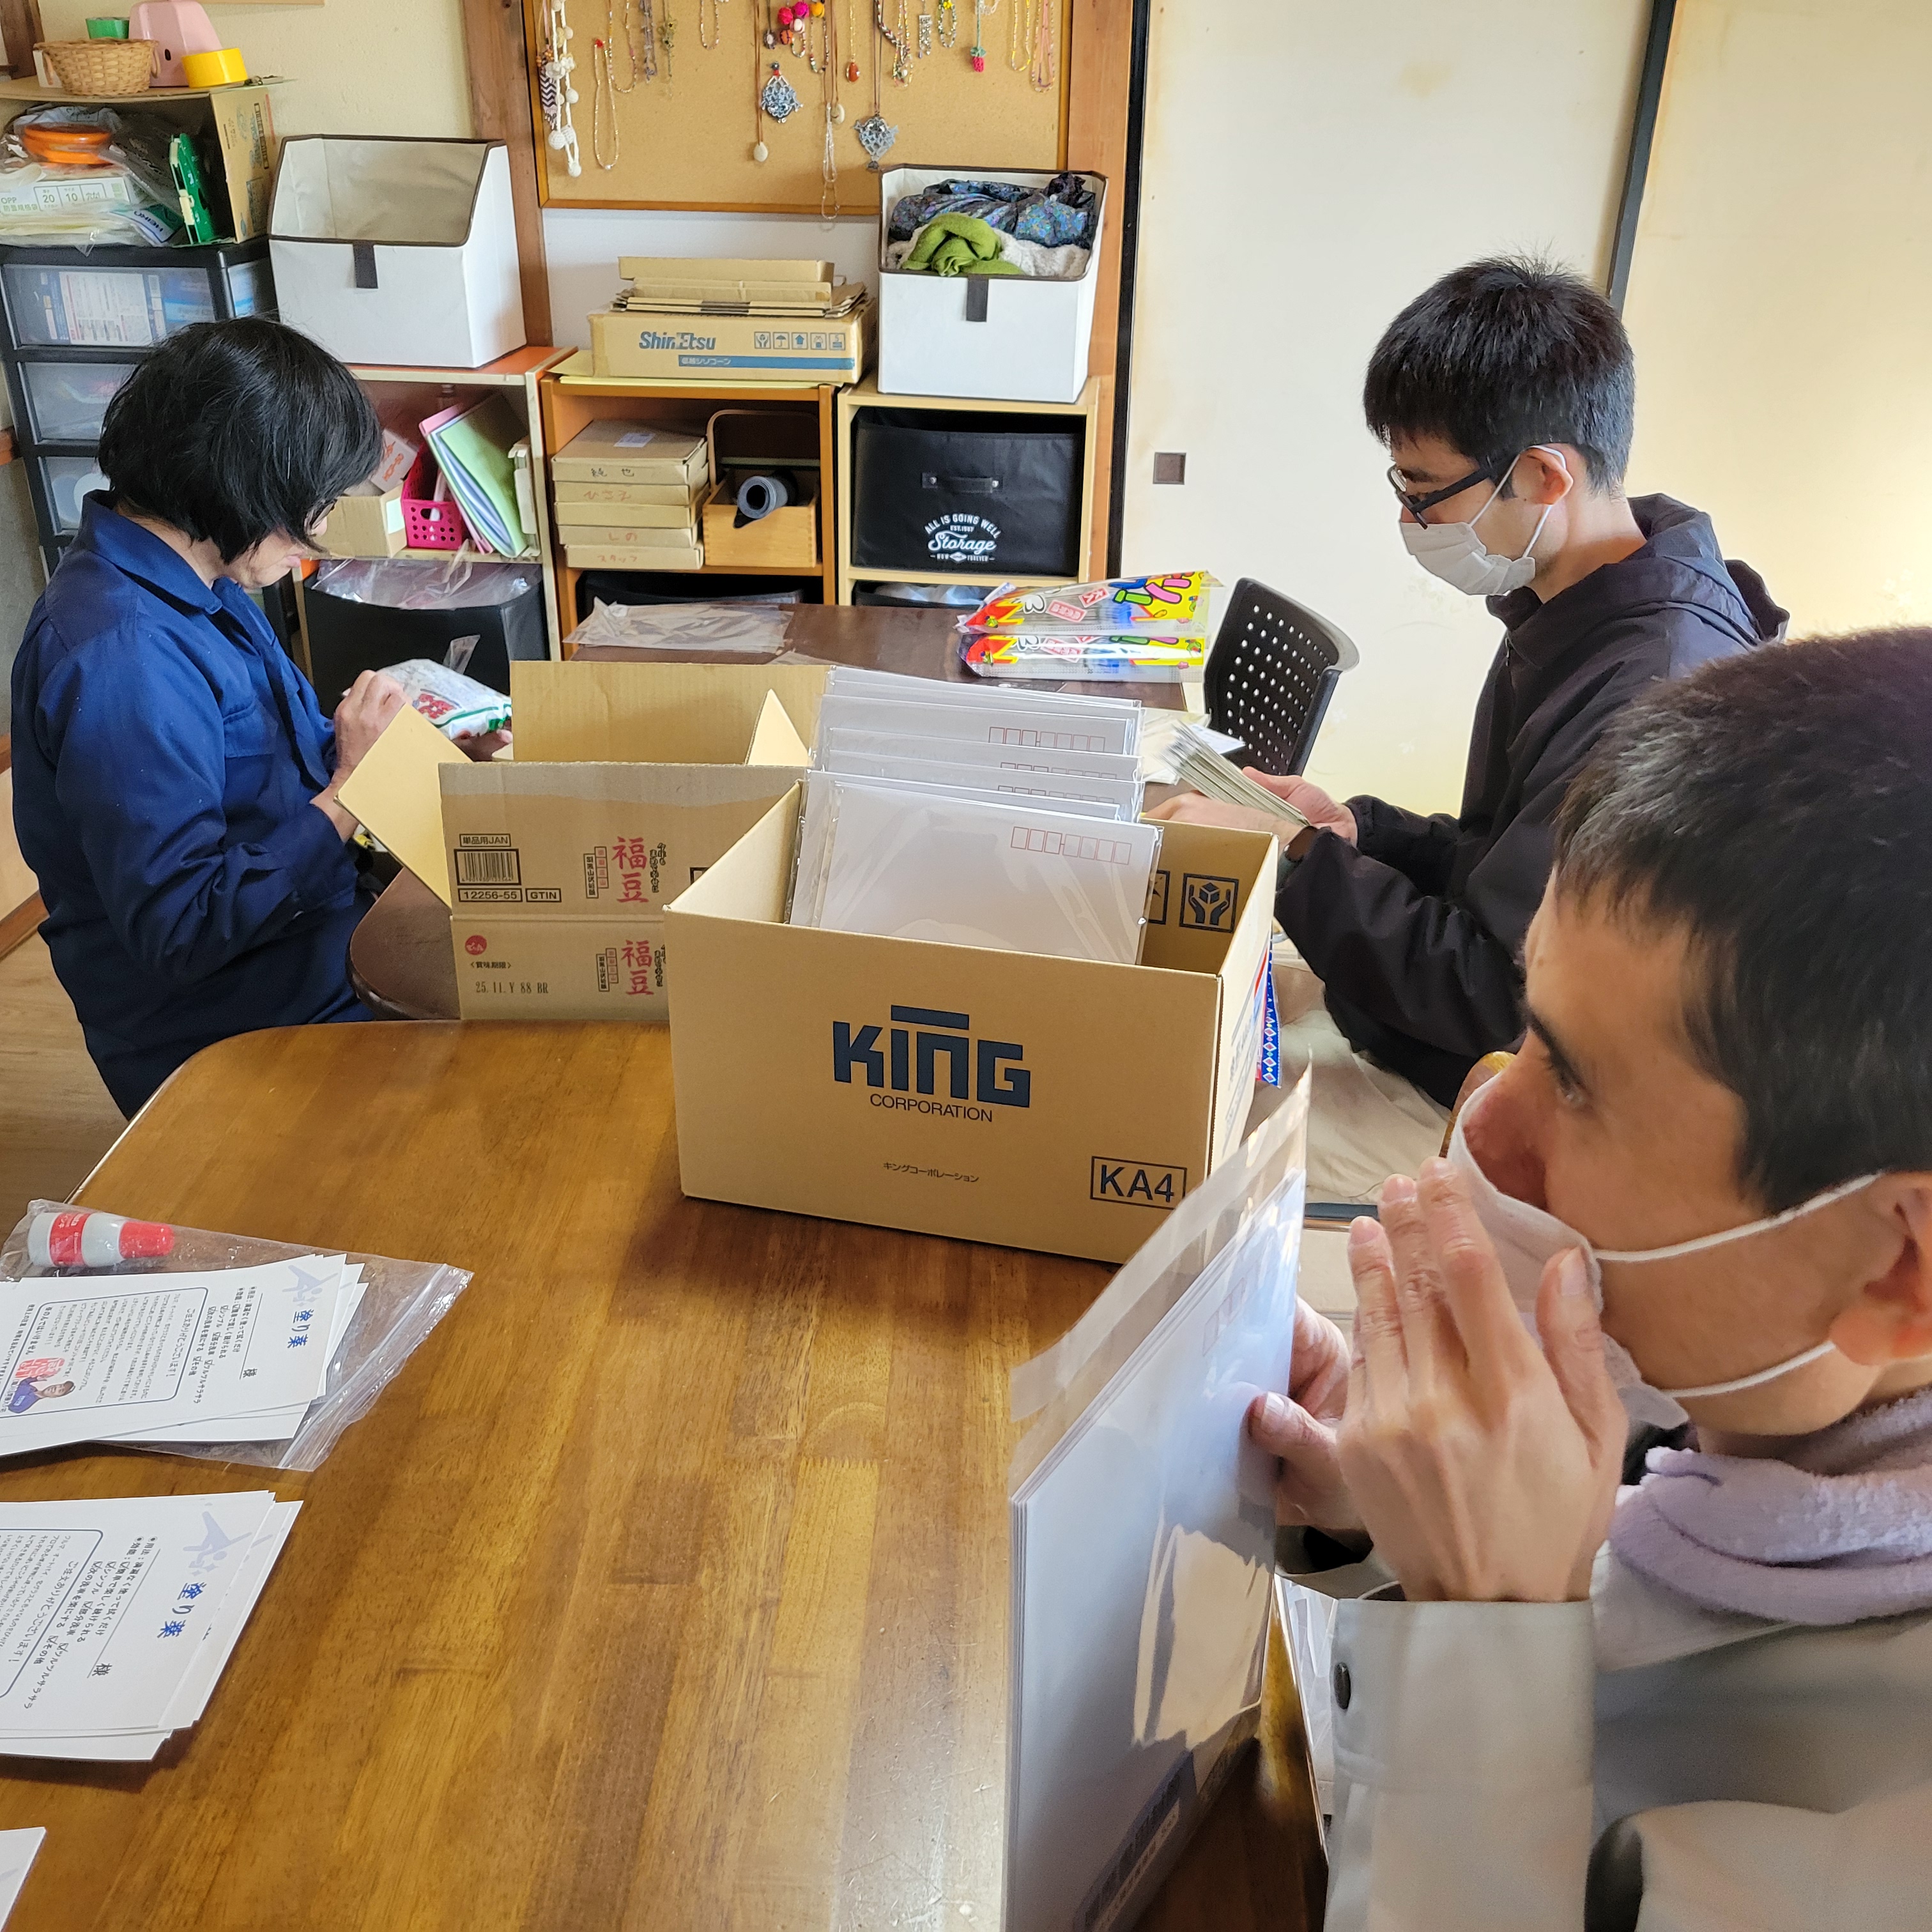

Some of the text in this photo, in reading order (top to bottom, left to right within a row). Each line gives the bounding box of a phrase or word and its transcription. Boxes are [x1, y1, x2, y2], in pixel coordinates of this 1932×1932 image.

[42, 194, 55, 203] 20
[65, 193, 78, 203] 10
[924, 513, 1002, 539] ALL IS GOING WELL
[928, 530, 997, 555] Storage
[463, 836, 509, 845] 単品用JAN
[611, 836, 650, 903] 福豆
[463, 891, 518, 900] 12256-55
[530, 891, 557, 900] GTIN
[620, 939, 655, 995] 福豆
[520, 982, 532, 994] 88
[537, 982, 549, 994] BR
[832, 1004, 1031, 1108] KING
[870, 1092, 993, 1123] CORPORATION
[883, 1162, 979, 1183] キングコーポレーション
[1100, 1164, 1174, 1203] KA4
[287, 1309, 314, 1348] 塗り薬
[241, 1367, 258, 1378] 様
[31, 1568, 99, 1664] 次の洗車を楽にする その他
[158, 1581, 207, 1638] 塗り薬
[20, 1568, 112, 1709] シンプル 部分洗車 ツルツルサラサラ
[92, 1664, 113, 1676] 様
